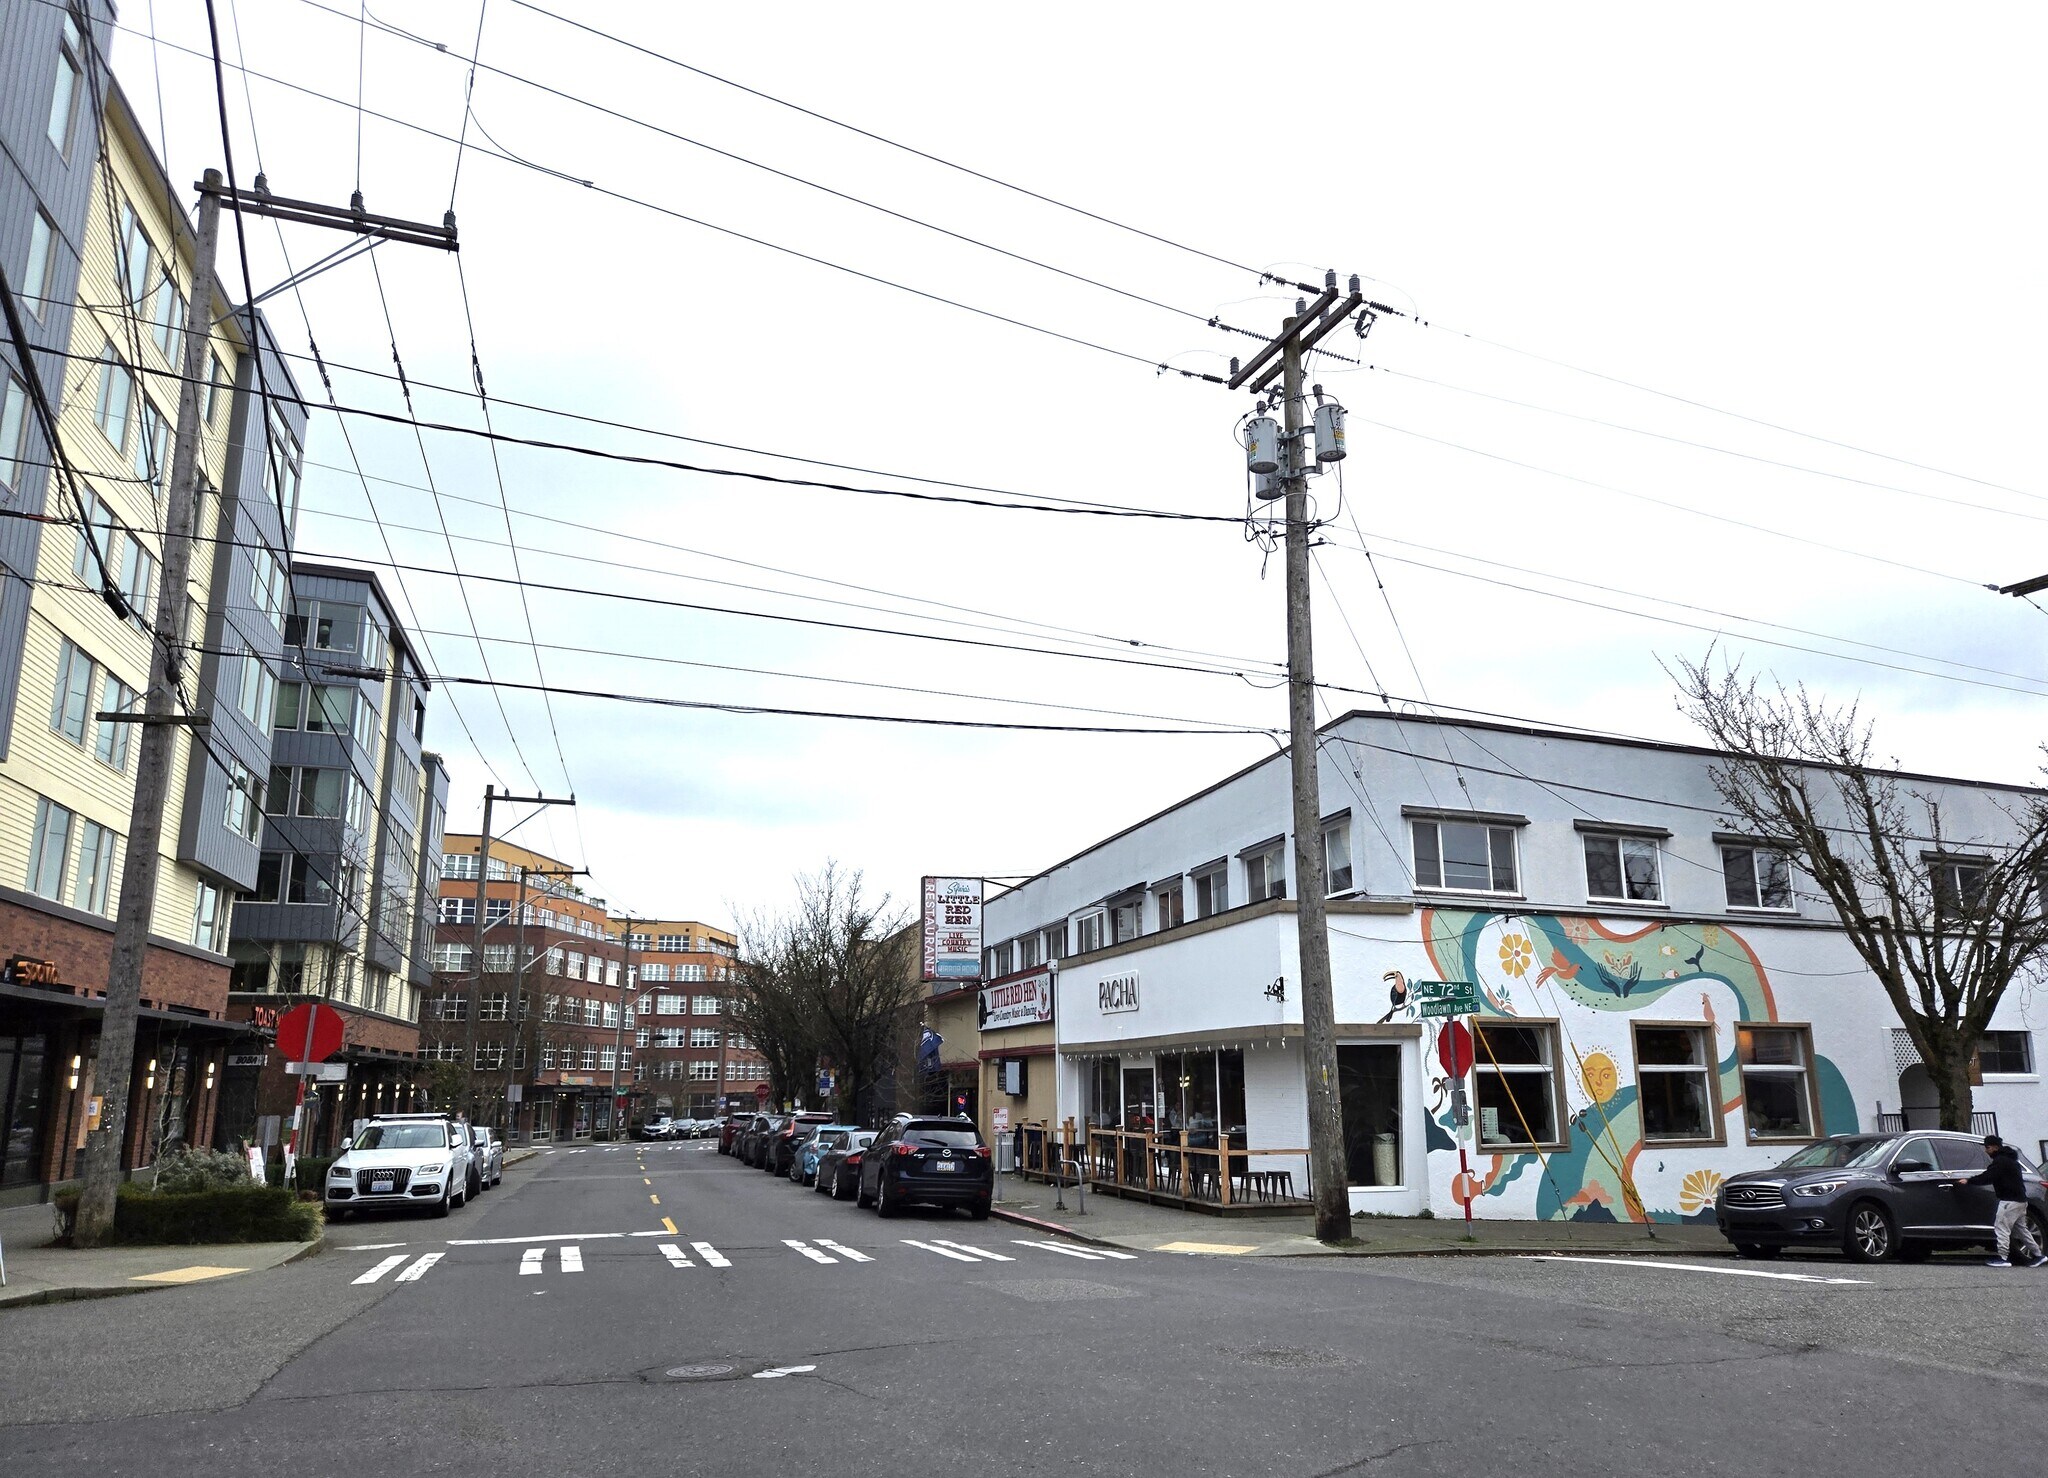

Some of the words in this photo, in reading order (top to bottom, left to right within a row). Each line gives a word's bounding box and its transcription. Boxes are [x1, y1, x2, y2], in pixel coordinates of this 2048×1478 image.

[937, 895, 980, 905] LITTLE
[945, 905, 971, 914] RED
[945, 915, 972, 925] HEN
[925, 884, 935, 974] RESTAURANT
[991, 986, 1009, 1009] LITTLE
[1010, 984, 1023, 1005] RED
[1023, 980, 1037, 1003] HEN
[1099, 976, 1137, 1009] PACHA
[1423, 985, 1434, 993] NE
[1464, 986, 1472, 994] St
[1024, 1004, 1037, 1019] Dancing
[1422, 1003, 1451, 1015] Woodlawn
[1453, 1004, 1463, 1012] Ave
[1464, 1003, 1472, 1012] NE
[255, 1006, 275, 1027] TOAST
[236, 1056, 258, 1064] BOBA
